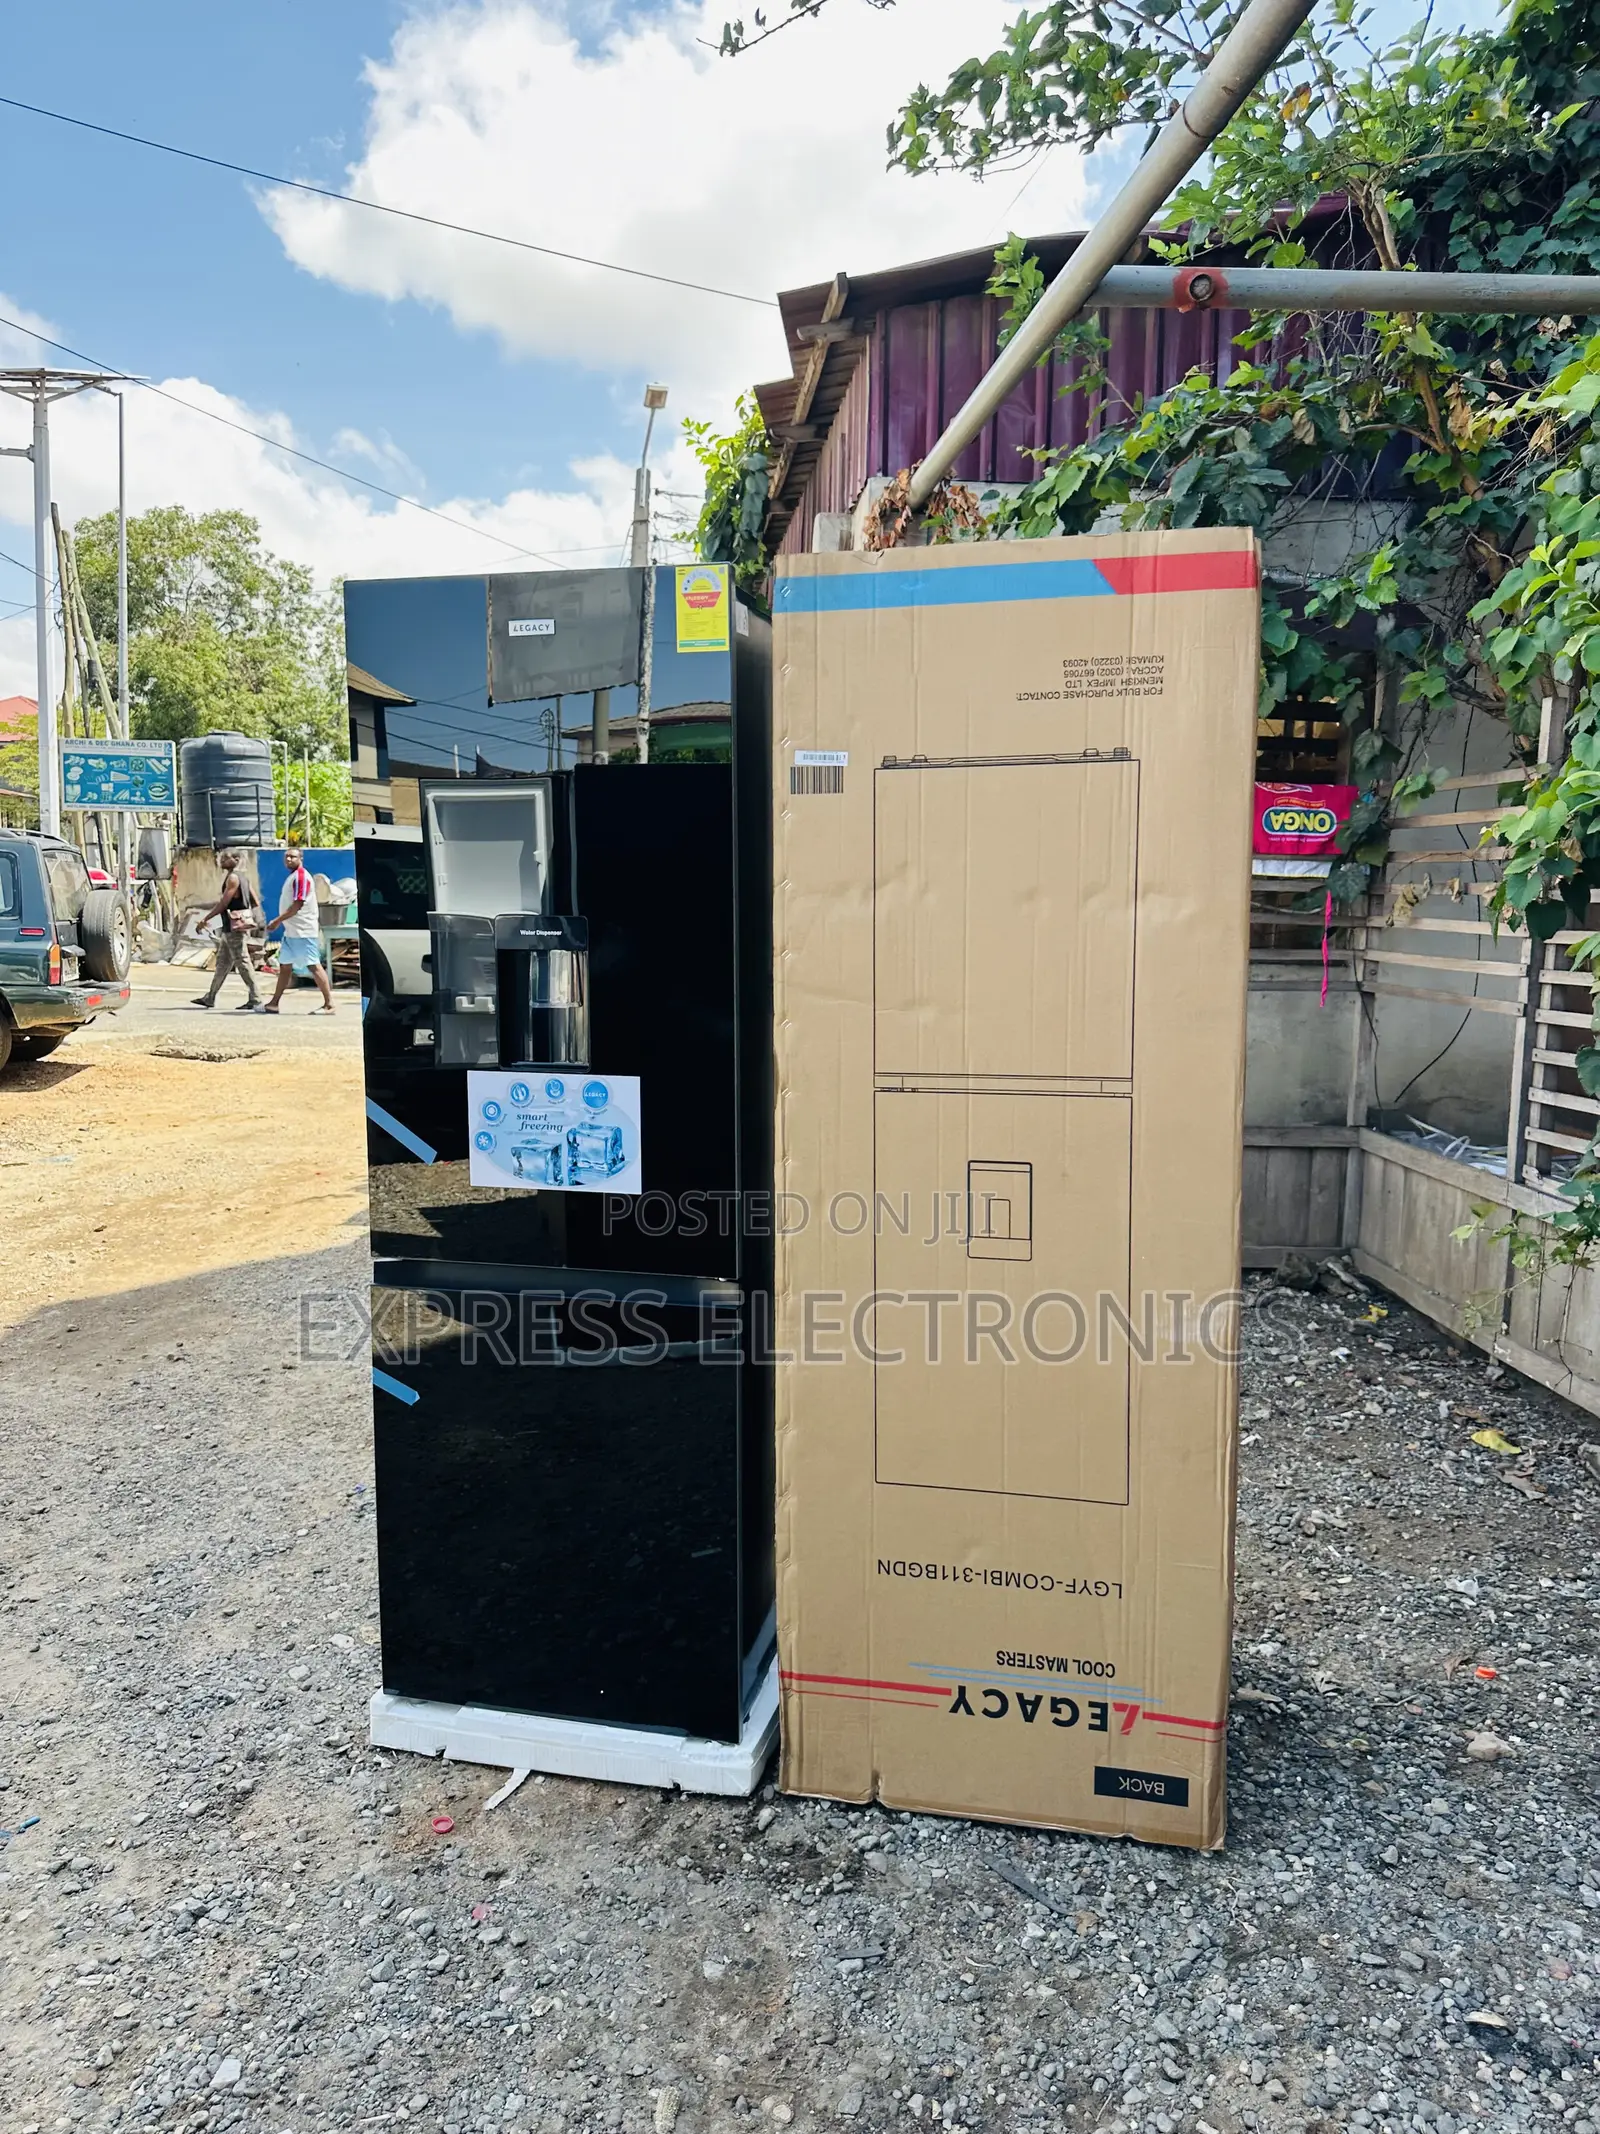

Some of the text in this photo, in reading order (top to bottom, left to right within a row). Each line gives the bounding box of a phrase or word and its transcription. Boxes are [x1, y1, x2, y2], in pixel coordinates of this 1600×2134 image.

[513, 624, 550, 632] LEGACY
[1062, 657, 1089, 668] 42093
[1090, 656, 1123, 667] (03220)
[1096, 666, 1124, 676] (0302)
[1065, 676, 1164, 688] MENKISH IMPEX LTD
[1062, 689, 1114, 699] PURCHASE
[1116, 688, 1140, 697] BULK
[1143, 687, 1163, 696] FOR
[1269, 811, 1331, 832] ONGA
[516, 1113, 549, 1121] smart
[518, 1121, 563, 1132] freezing
[877, 1558, 1123, 1599] LGYF-COMBI-311BGDN
[996, 1650, 1116, 1678] COOL MASTERS
[949, 1685, 1141, 1736] LEGACY
[1118, 1775, 1165, 1796] BACK
